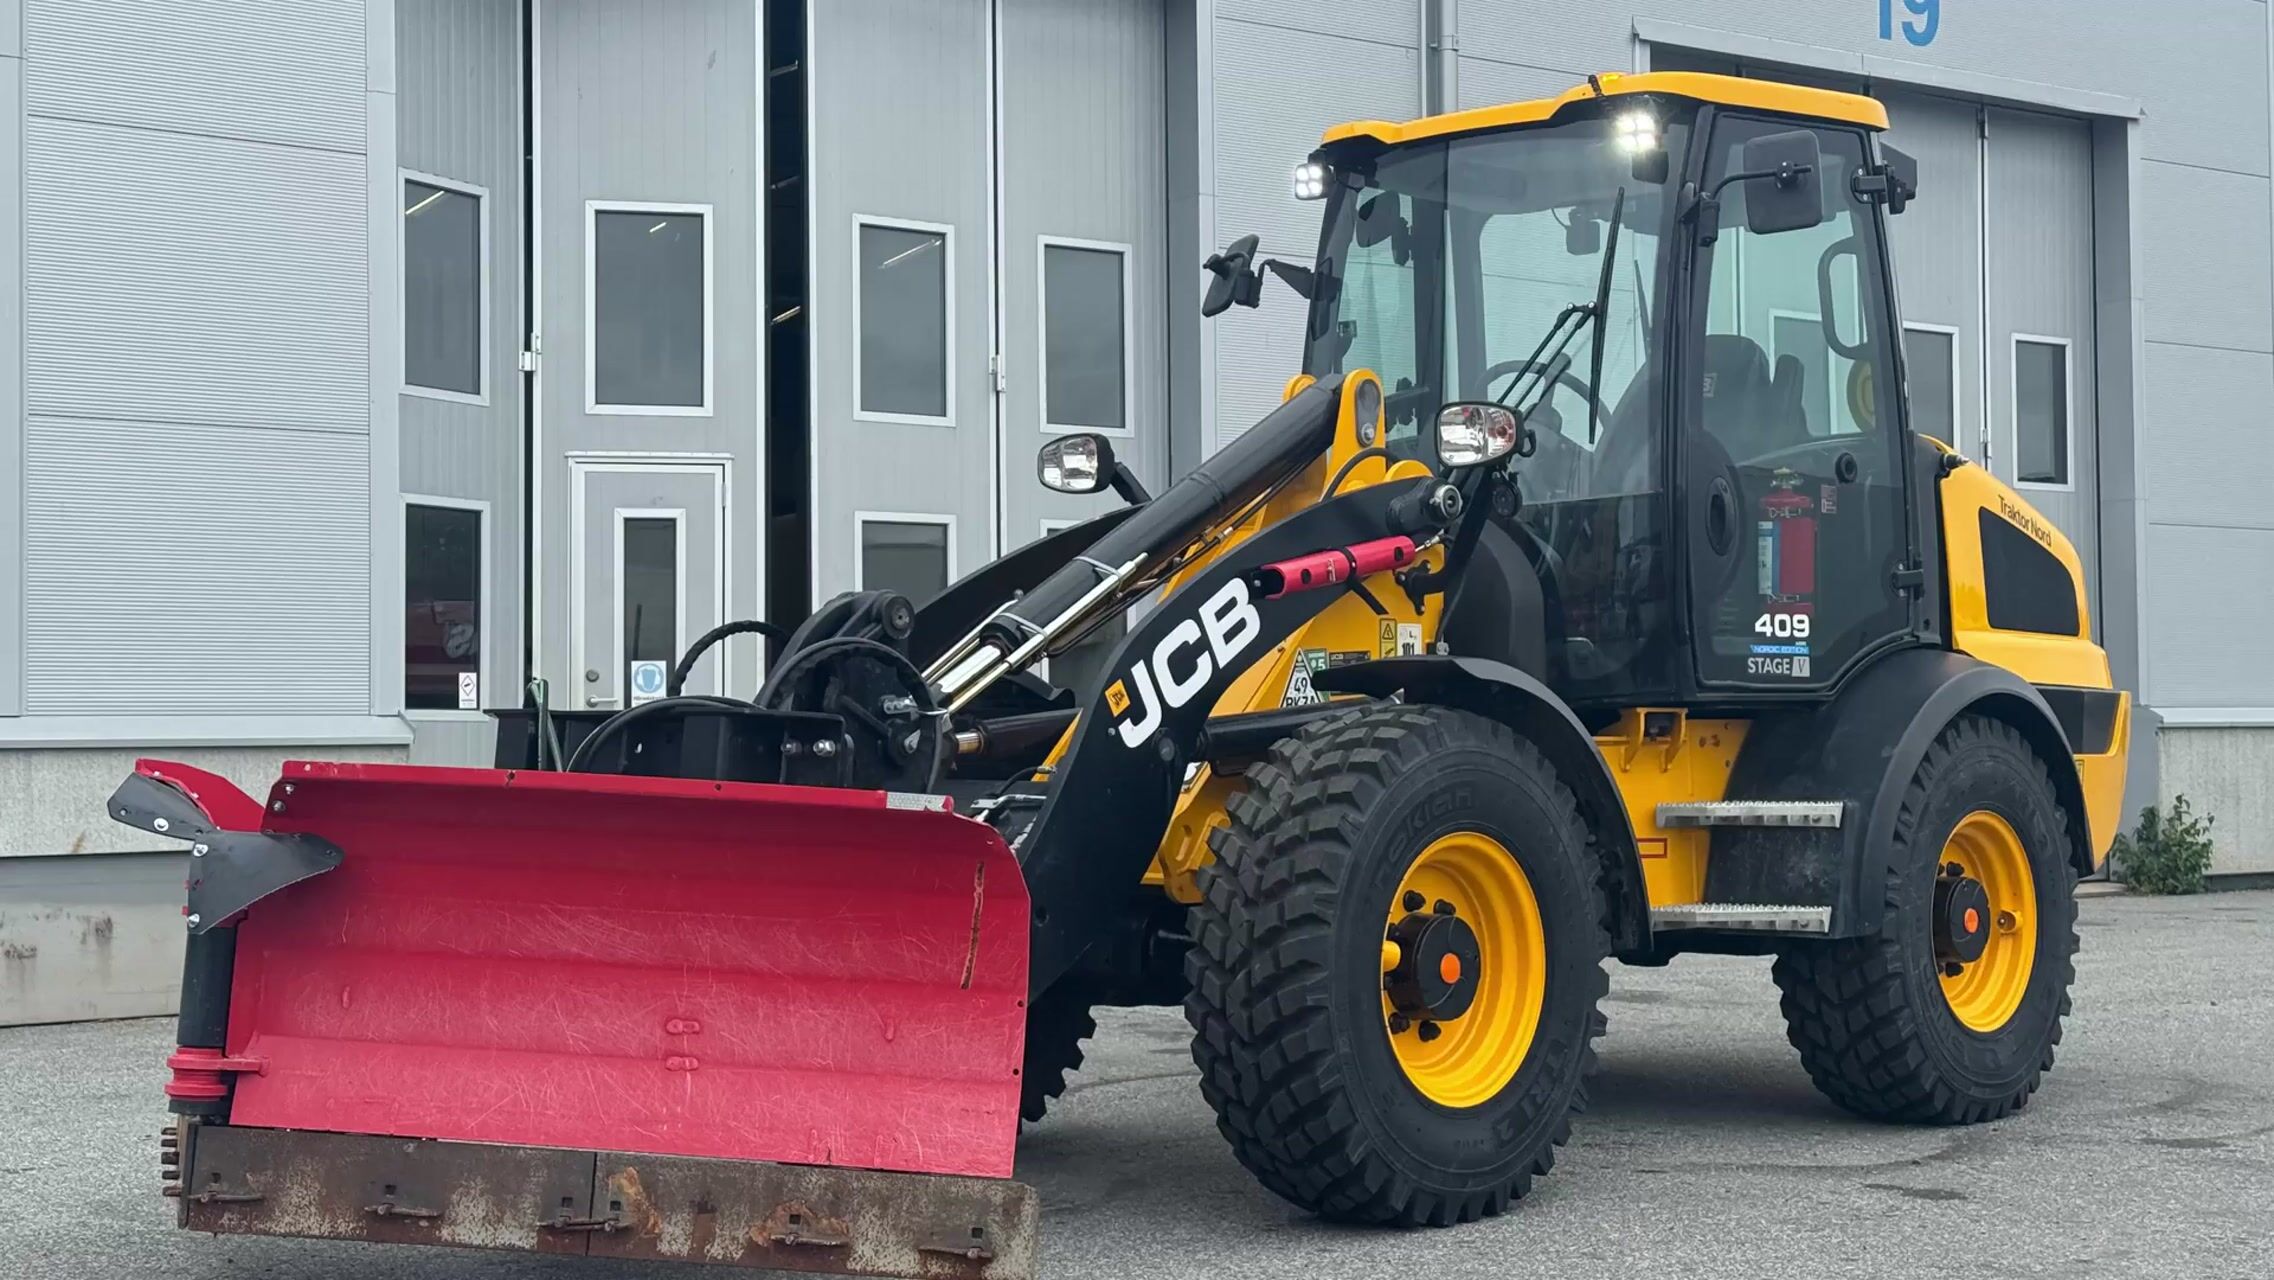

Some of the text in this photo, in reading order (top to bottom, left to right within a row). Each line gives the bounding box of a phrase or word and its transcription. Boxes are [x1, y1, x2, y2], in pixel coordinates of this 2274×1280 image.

[1879, 0, 1940, 46] 19
[1998, 494, 2051, 547] Traktor Nord
[1755, 613, 1810, 638] 409
[1118, 578, 1260, 748] JCB
[1747, 657, 1791, 674] STAGE
